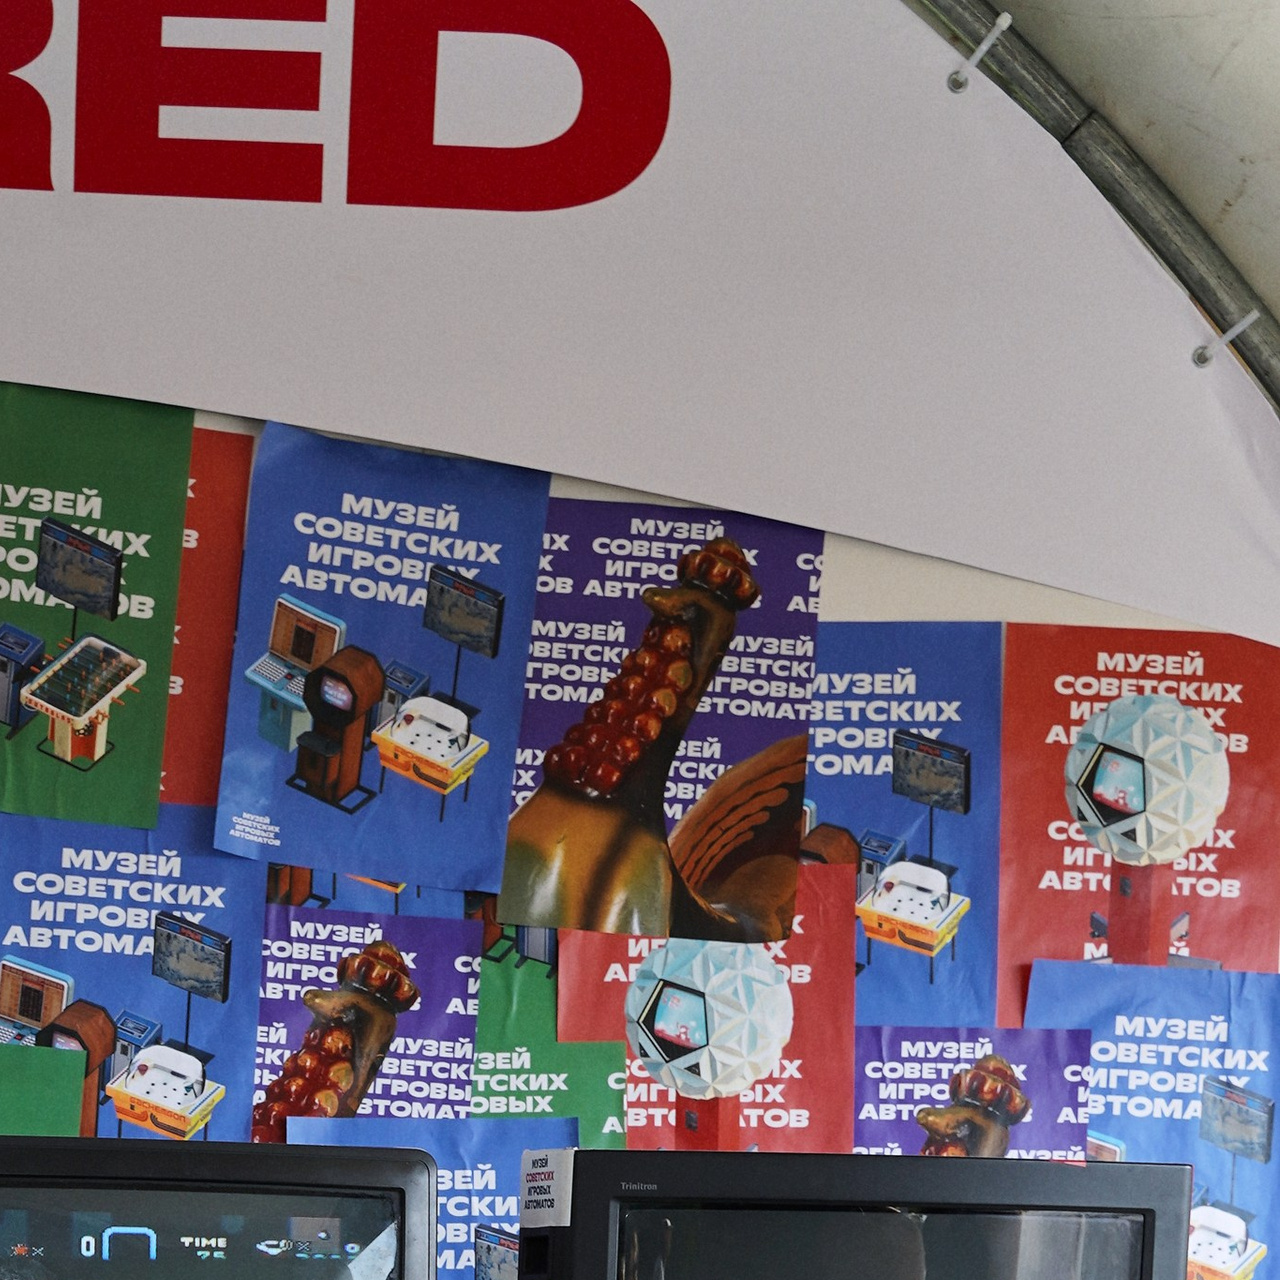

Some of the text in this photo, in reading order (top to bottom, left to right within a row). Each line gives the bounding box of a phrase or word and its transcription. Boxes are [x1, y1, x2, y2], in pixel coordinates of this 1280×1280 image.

[341, 493, 460, 532] МУЗЕЙ
[293, 512, 503, 565] СОВЕТСКИХ
[630, 518, 724, 540] МУЗЕЙ
[605, 559, 679, 581] ИГРО
[279, 565, 429, 609] АВТОМА
[531, 620, 626, 643] МУЗЕЙ
[721, 656, 815, 678] ВЕТСК
[1097, 651, 1204, 676] МУЗЕЙ
[1054, 674, 1243, 704] СОВЕТСКИХ
[674, 738, 721, 760] ЗЕЙ
[61, 847, 181, 877] МУЗЕЙ
[12, 871, 226, 908] СОВЕТСКИХ
[2, 925, 156, 956] АВТОМА
[290, 920, 383, 944] МУЗЕЙ
[265, 961, 339, 983] ИГРО
[1115, 1014, 1228, 1042] МУЗЕЙ
[473, 1047, 531, 1070] ЗЕЙ
[900, 1038, 994, 1059] МУЗЕЙ
[1090, 1042, 1270, 1073] ОВЕТСКИХ
[380, 1057, 476, 1080] ВЕТСК
[878, 1083, 952, 1100] ИГРО
[531, 1154, 549, 1169] МУЗЕЙ
[436, 1164, 497, 1190] ЗЕЙ
[525, 1171, 555, 1183] СОВЕТСКИХ
[621, 1181, 657, 1191] Trinitron
[527, 1185, 551, 1197] ИГРОВЫХ
[523, 1198, 555, 1210] АВТОМАТОВ
[180, 1237, 228, 1249] TIME
